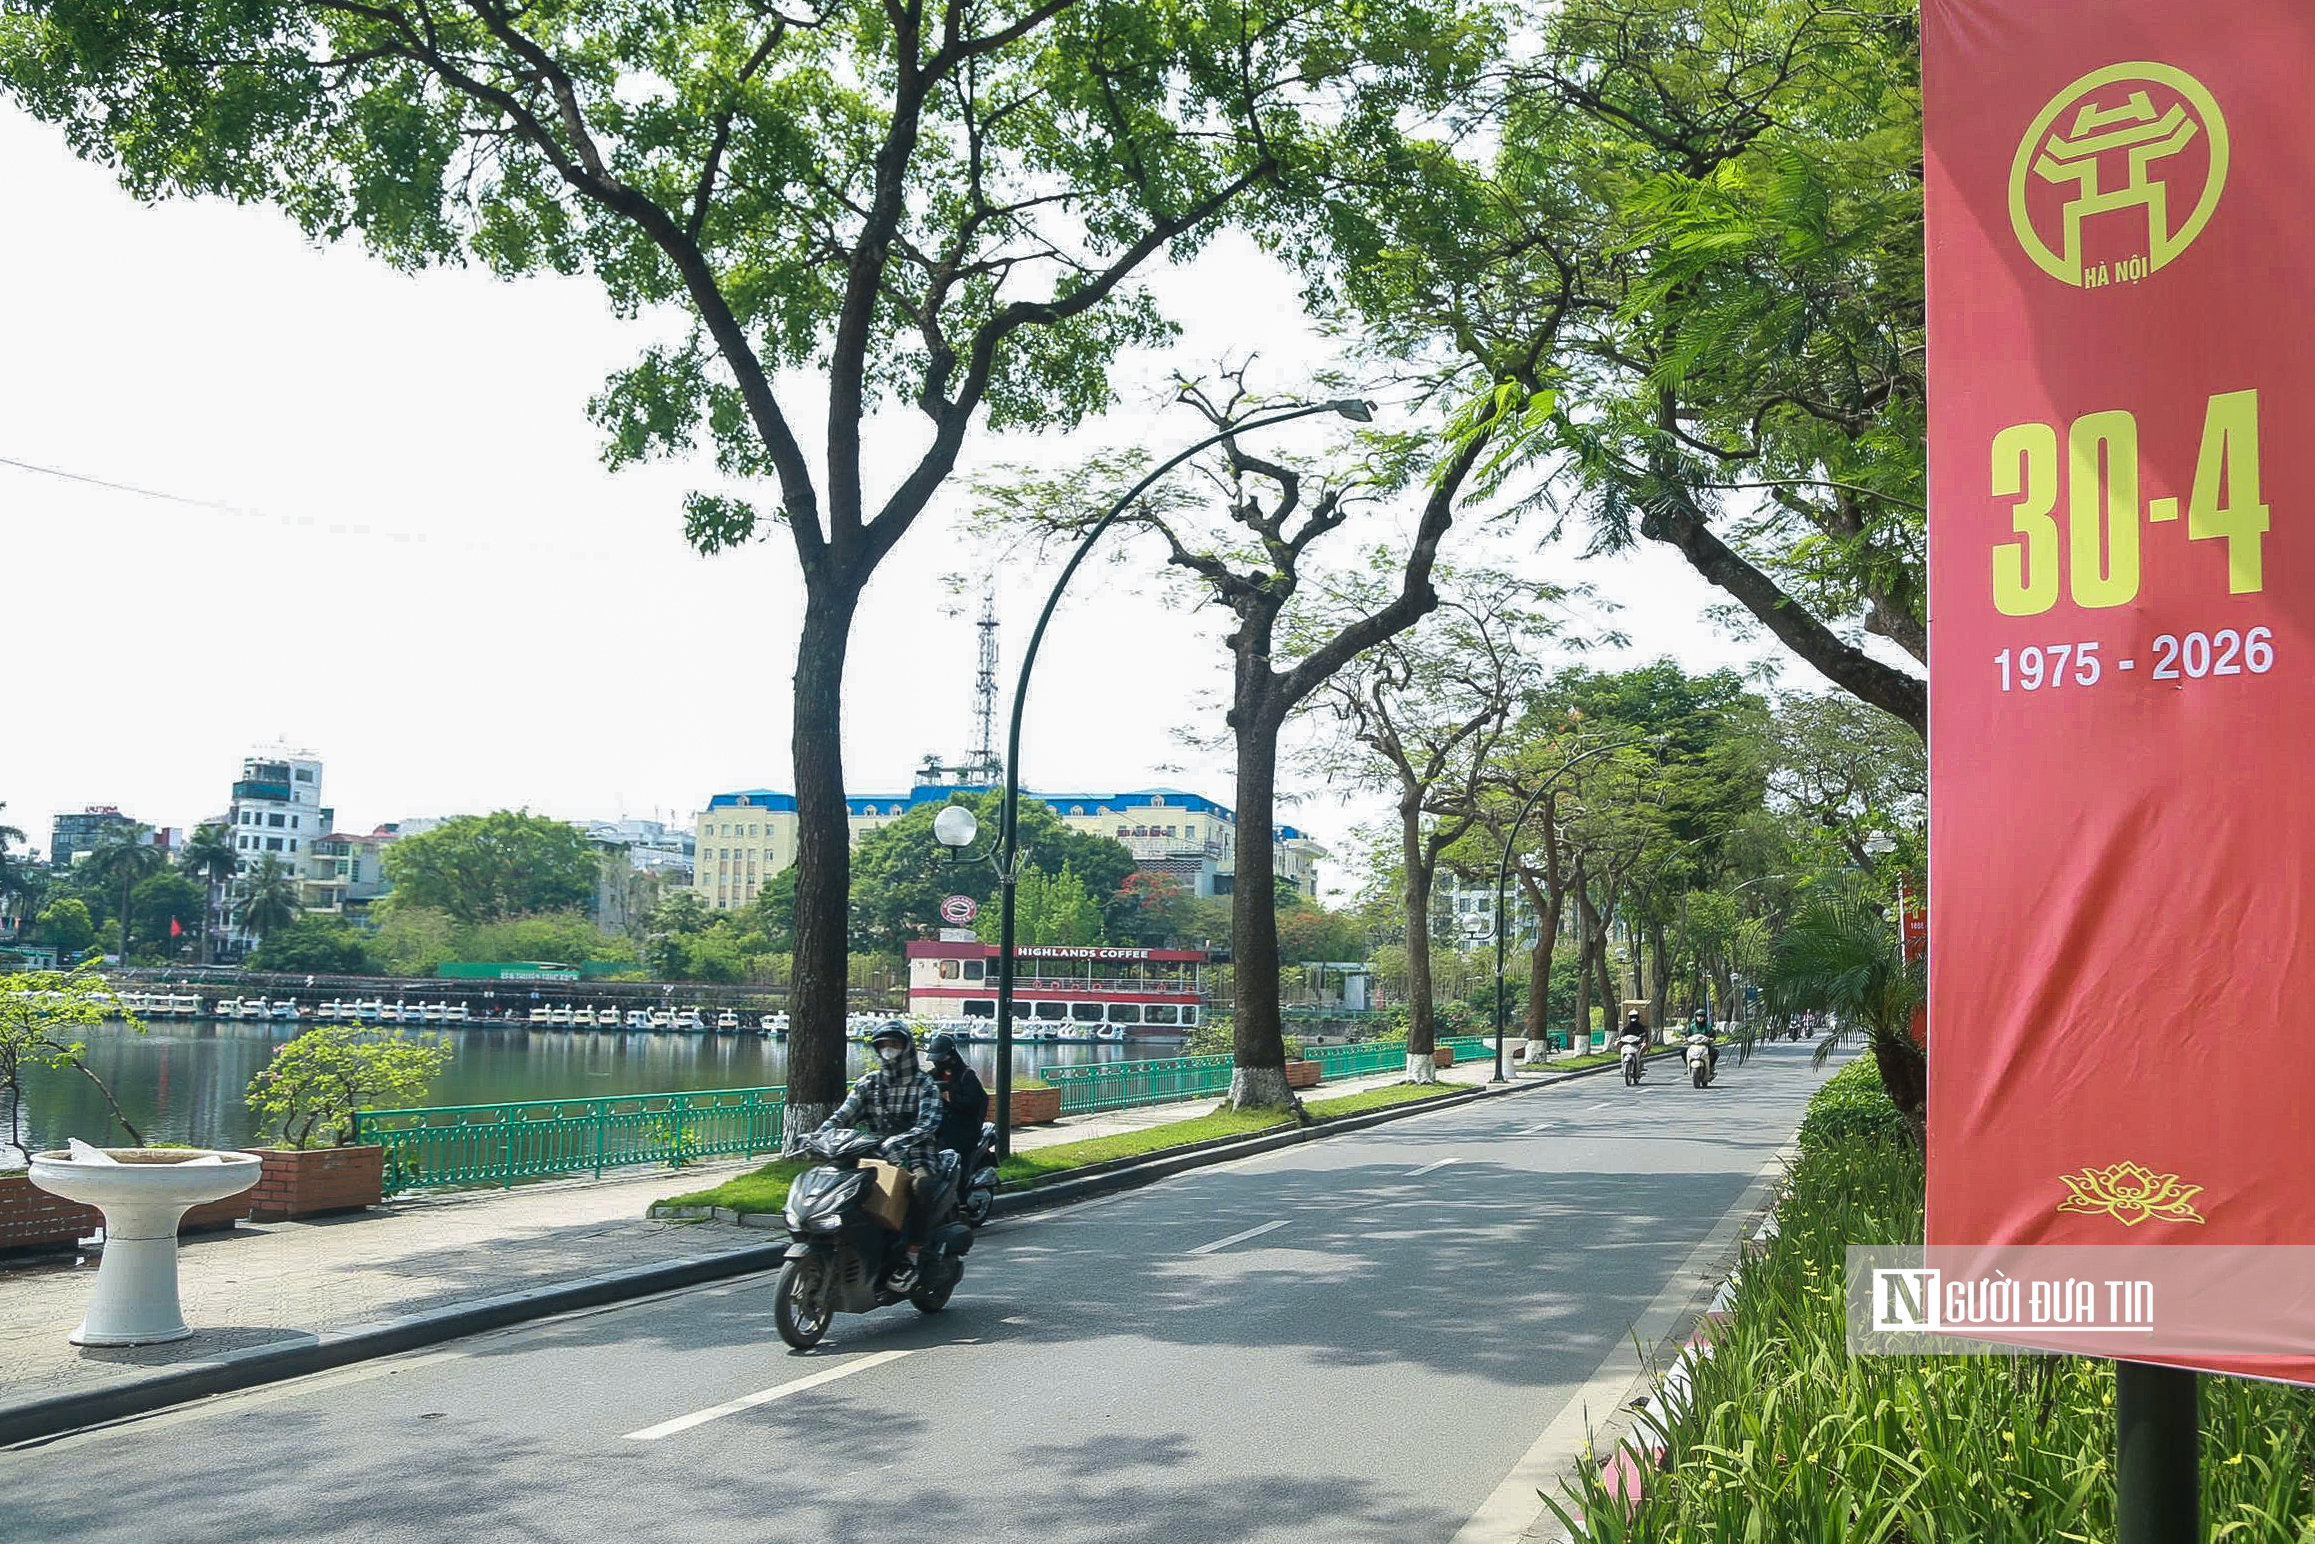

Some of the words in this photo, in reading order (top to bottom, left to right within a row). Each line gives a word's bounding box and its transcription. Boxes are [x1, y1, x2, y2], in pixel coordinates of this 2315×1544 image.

[2084, 261, 2110, 290] HÀ
[2115, 253, 2149, 285] NỘI
[1991, 388, 2271, 617] 30-4
[1994, 641, 2101, 692] 1975
[2118, 659, 2135, 671] -
[2152, 626, 2274, 680] 2026
[1018, 947, 1097, 958] HIGHLANDS
[1099, 949, 1149, 959] COFFEE
